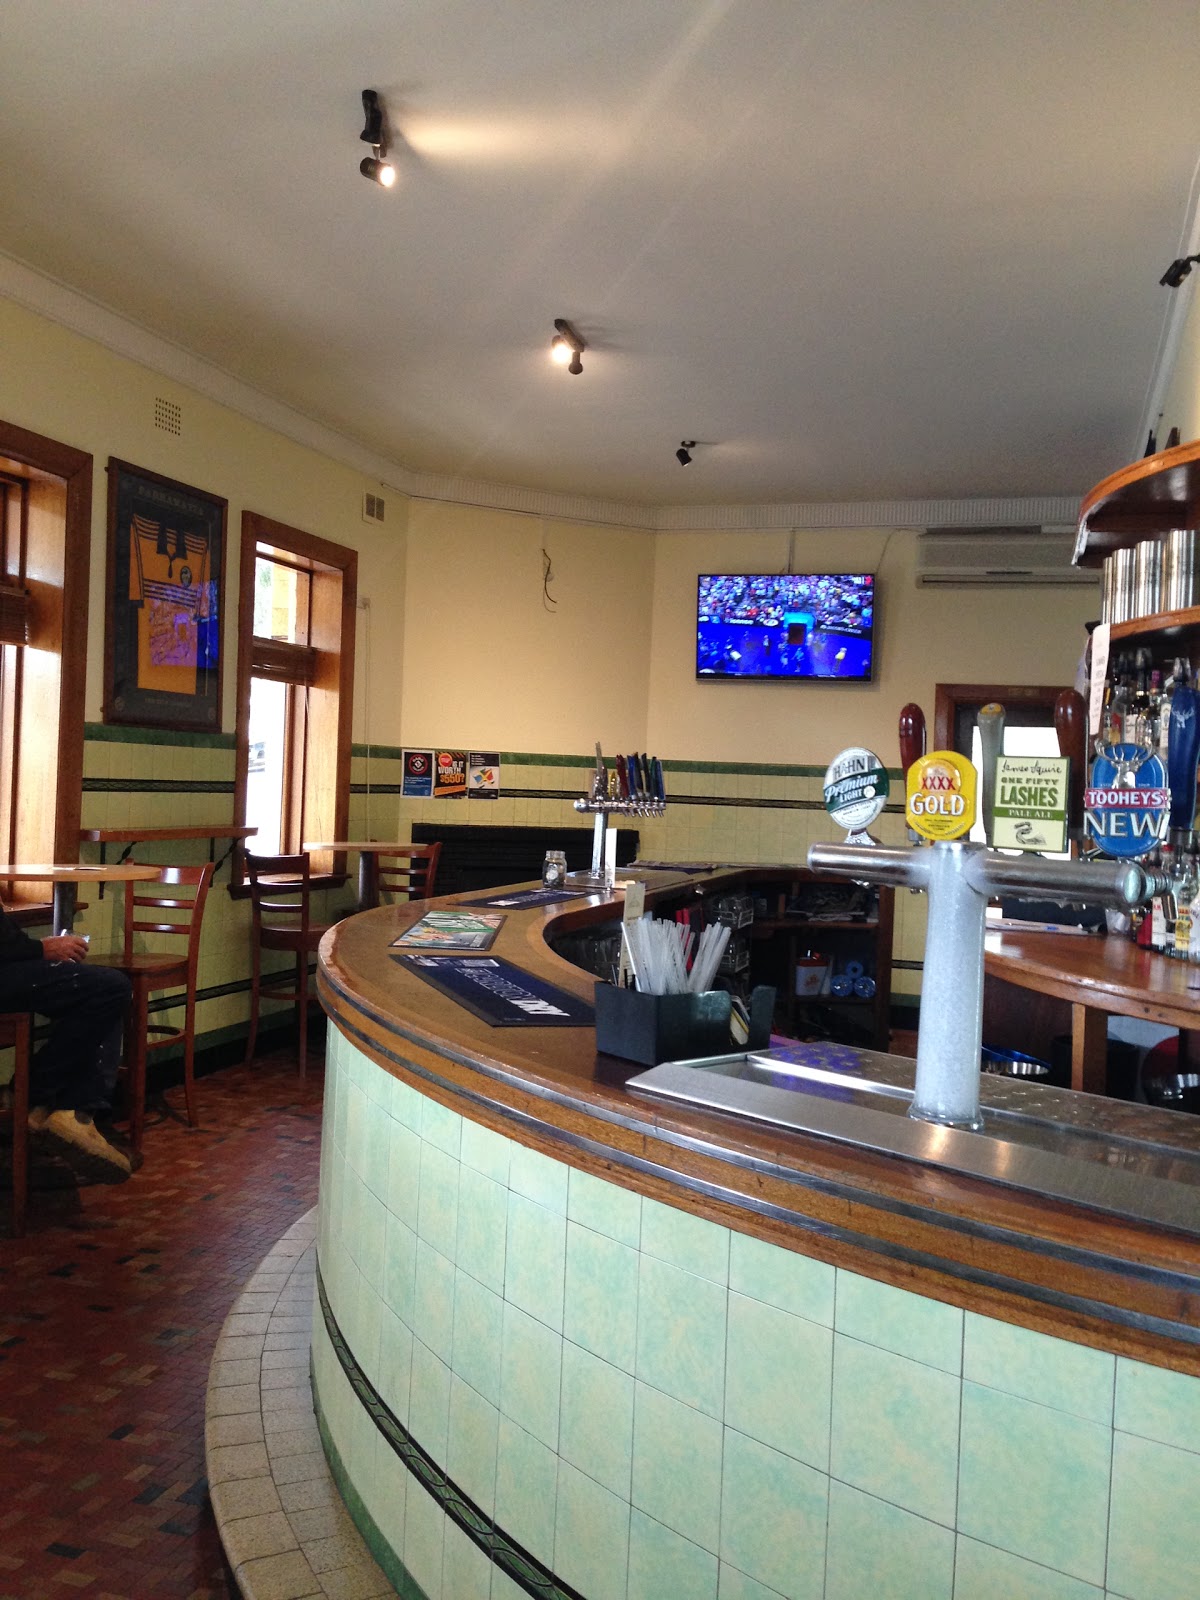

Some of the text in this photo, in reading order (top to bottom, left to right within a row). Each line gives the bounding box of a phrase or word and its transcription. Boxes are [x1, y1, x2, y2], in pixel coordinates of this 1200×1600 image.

[438, 766, 462, 774] WORTH
[832, 757, 866, 781] HAHN
[440, 773, 465, 784] $550?
[921, 776, 956, 790] XXXX
[1026, 777, 1060, 785] FIFTY
[825, 775, 878, 803] Premium
[840, 788, 863, 802] LIGHT
[1000, 785, 1059, 807] LASHES
[910, 792, 965, 816] GOLD
[1088, 791, 1164, 805] TOOHEYS
[1008, 809, 1053, 819] PALE ALE
[1083, 812, 1165, 839] NEW
